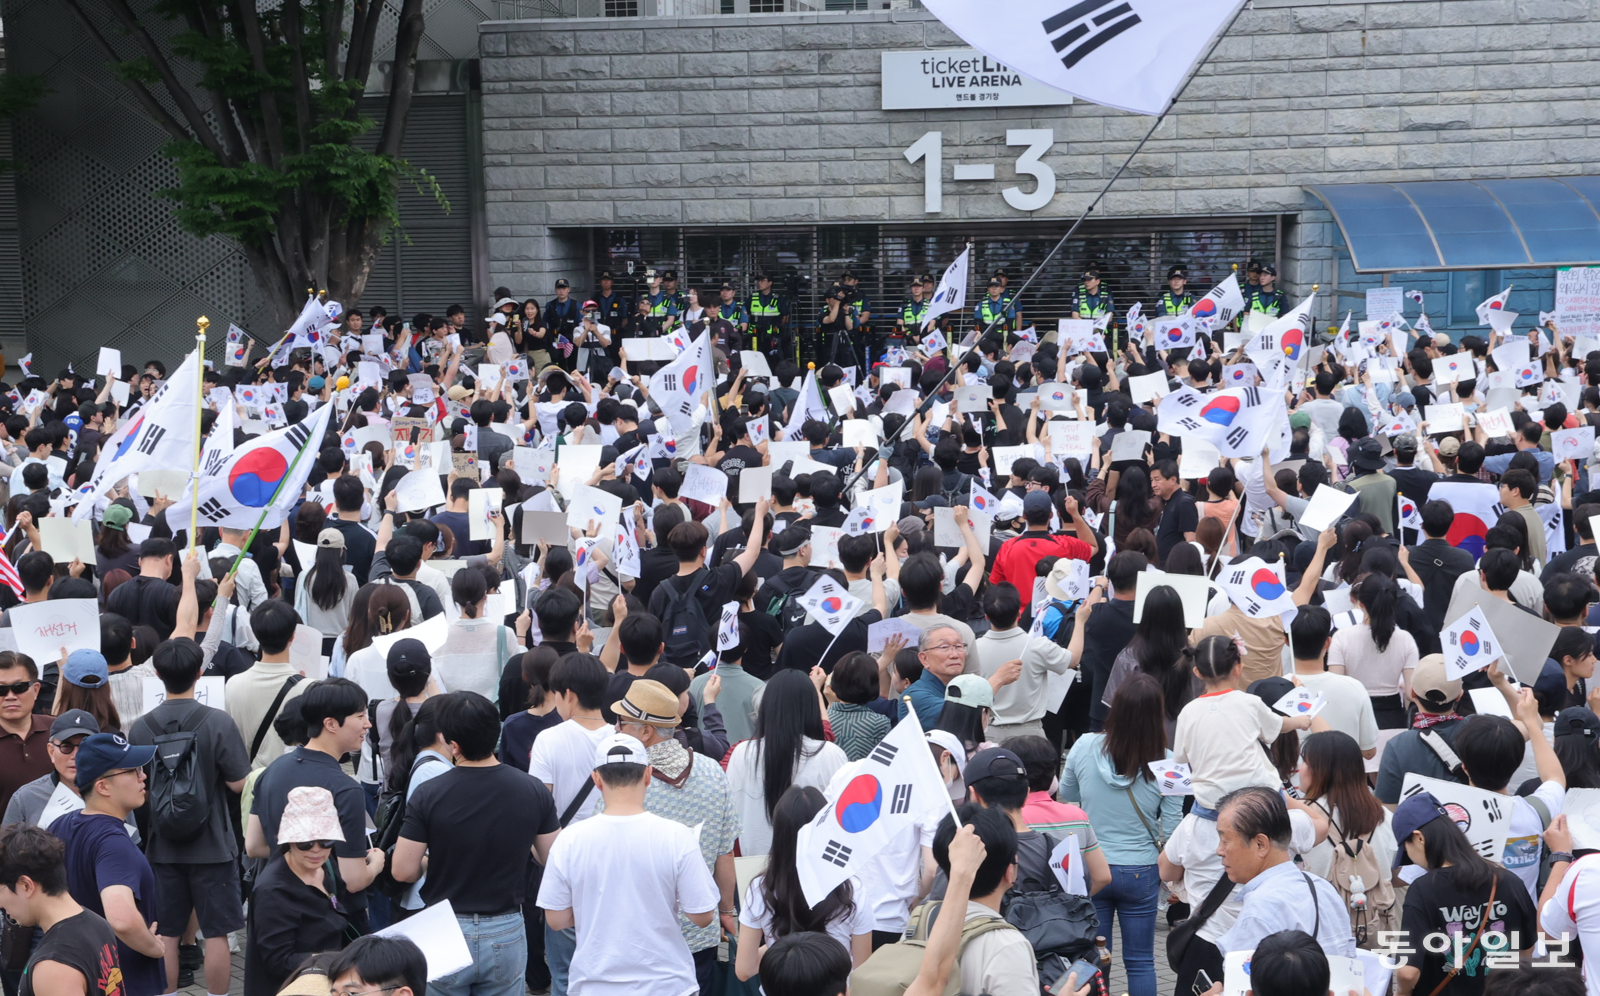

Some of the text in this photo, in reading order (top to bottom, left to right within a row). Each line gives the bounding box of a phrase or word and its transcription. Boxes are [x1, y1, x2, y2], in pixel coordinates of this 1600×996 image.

[932, 74, 1022, 88] LIVE ARENA
[956, 92, 1000, 101] 핸드볼 경기장
[902, 128, 1057, 213] 1-3
[394, 428, 433, 442] 재거
[1061, 424, 1080, 433] STOP
[1064, 434, 1080, 442] THE
[720, 458, 746, 471] KOREA
[34, 622, 78, 637] 재선거
[1439, 904, 1482, 930] Way
